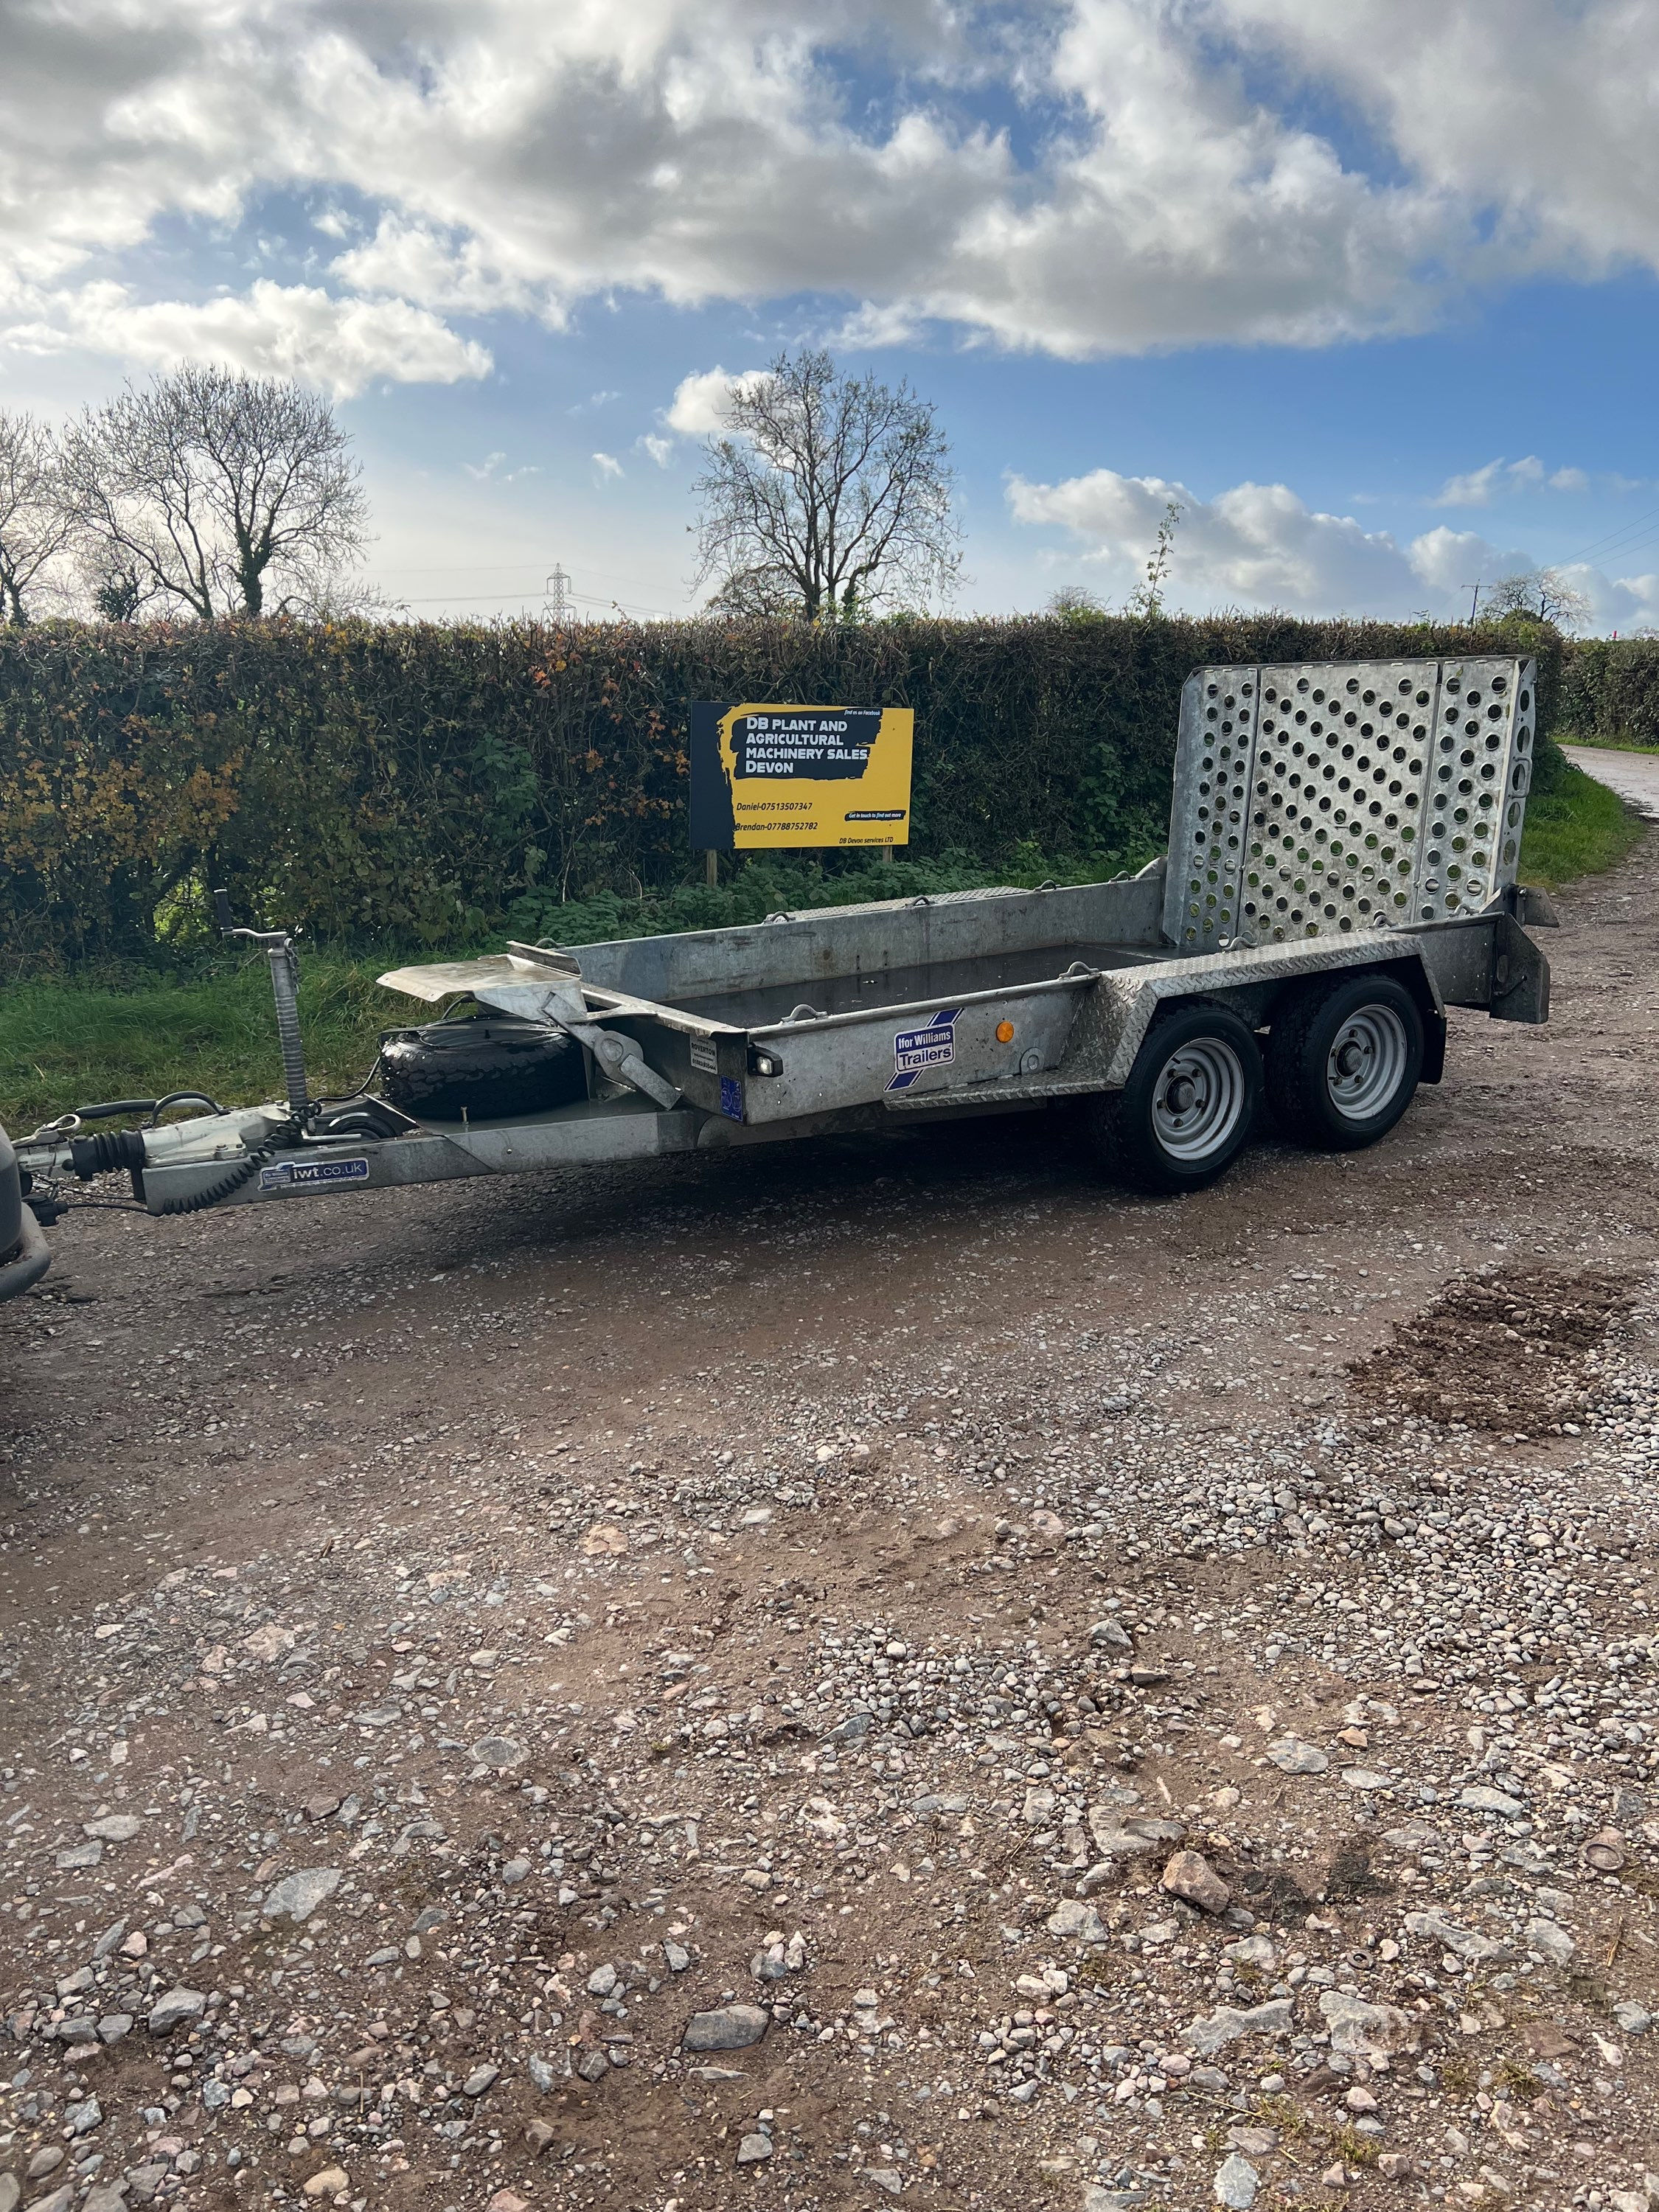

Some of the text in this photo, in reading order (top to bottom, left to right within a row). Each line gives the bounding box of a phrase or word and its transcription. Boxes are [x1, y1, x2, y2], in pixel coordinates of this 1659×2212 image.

[746, 717, 848, 731] DB PLANT AND
[745, 733, 844, 745] AGRICULTURAL
[745, 747, 868, 759] MACHINERY SALES
[736, 802, 813, 810] Daniel-07513507347
[735, 822, 818, 831] Brendan-07788752782
[898, 1032, 951, 1049] Ifor Williams
[899, 1048, 951, 1066] Trailers
[293, 1162, 363, 1180] iwt.co.uk
